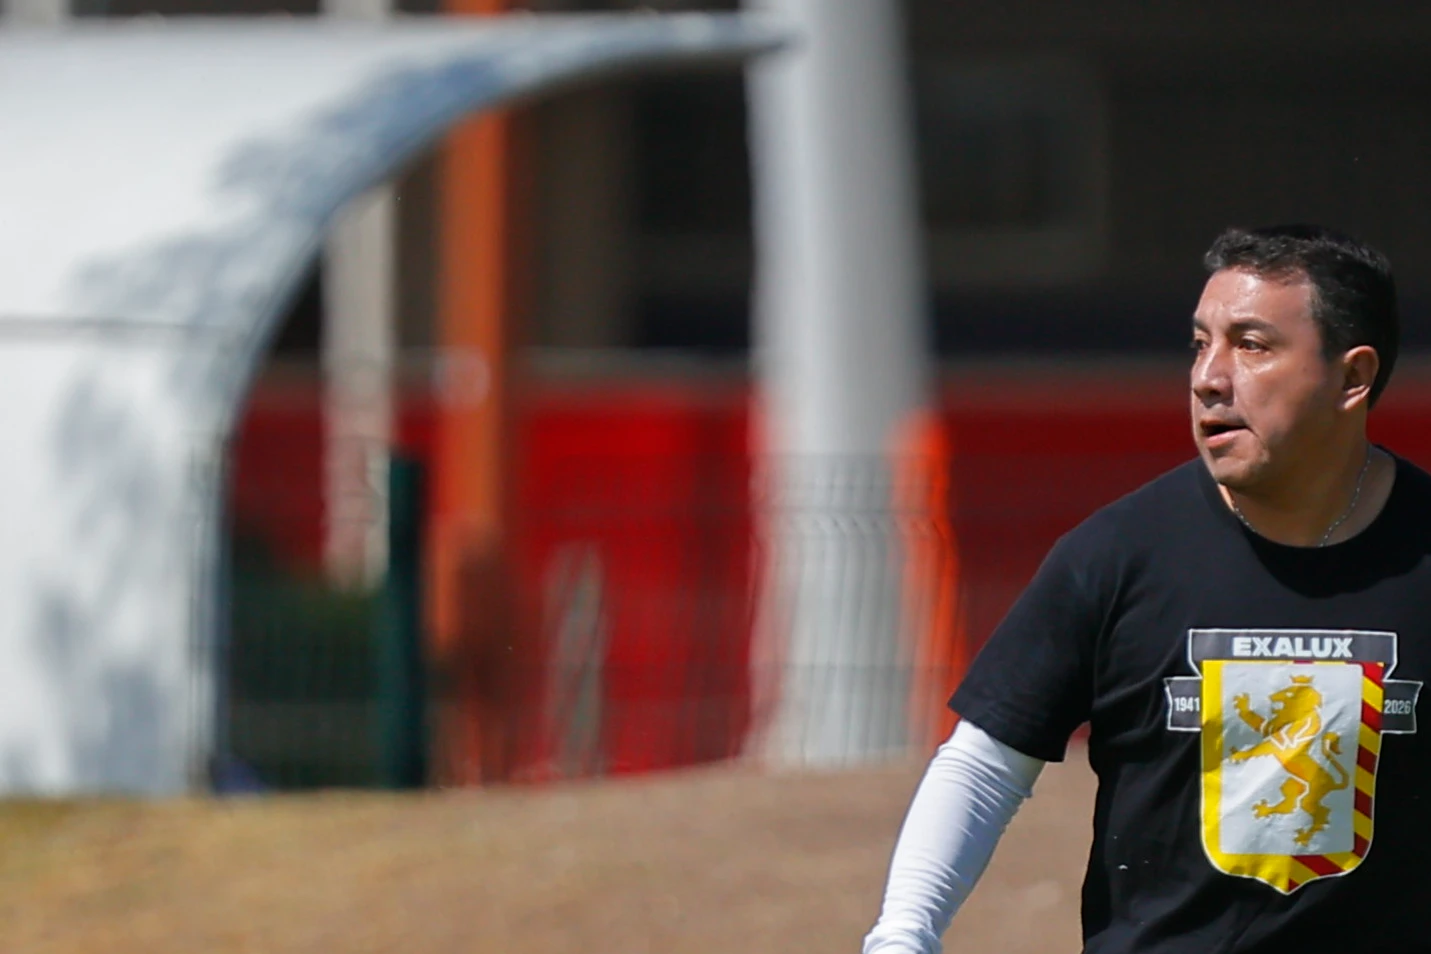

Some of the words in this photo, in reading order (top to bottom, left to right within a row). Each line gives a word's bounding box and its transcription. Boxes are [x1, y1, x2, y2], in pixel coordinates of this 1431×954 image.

[1231, 636, 1353, 658] EXALUX
[1174, 696, 1200, 712] 1941
[1383, 699, 1411, 715] 2026
